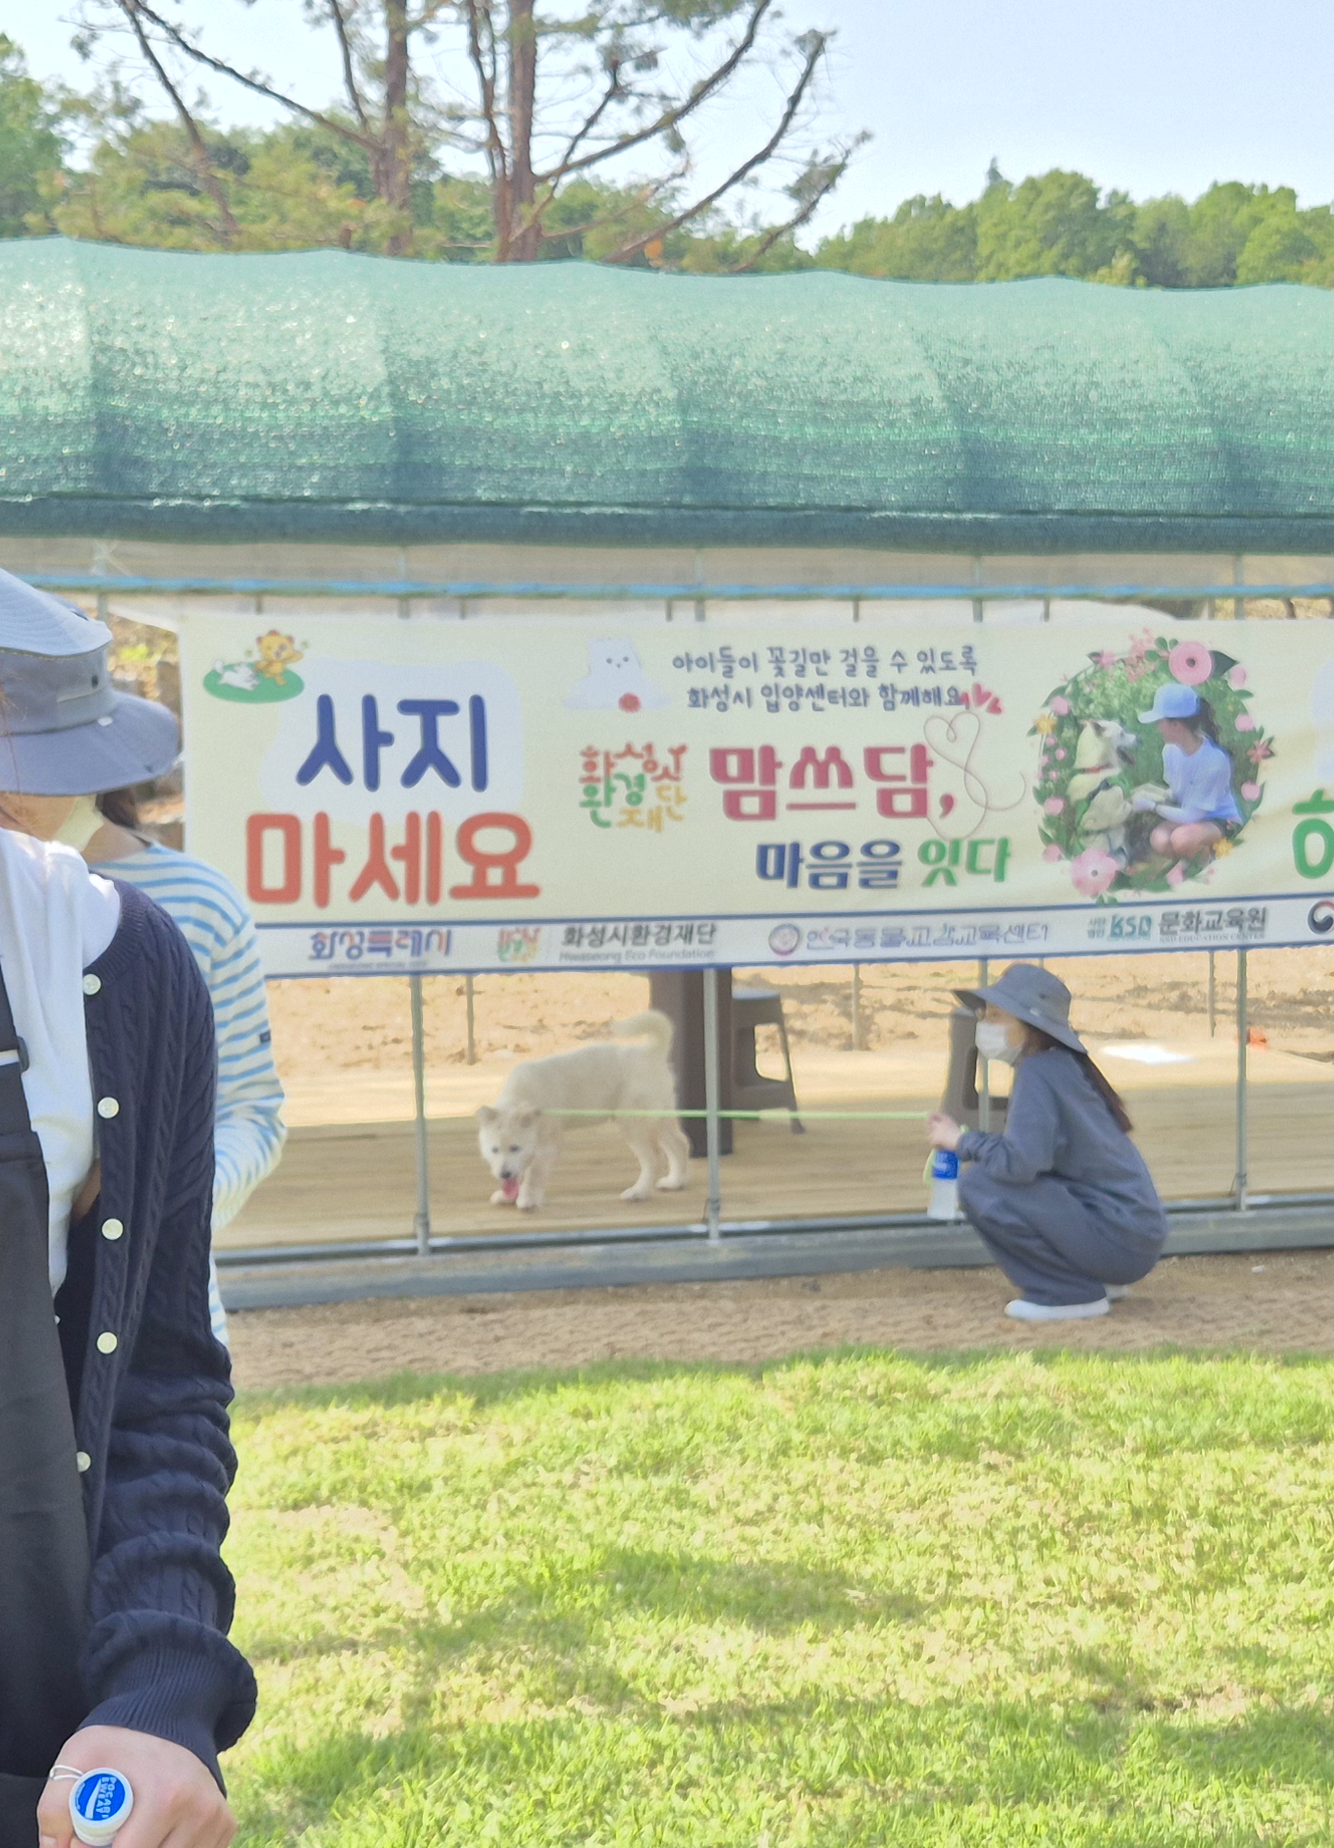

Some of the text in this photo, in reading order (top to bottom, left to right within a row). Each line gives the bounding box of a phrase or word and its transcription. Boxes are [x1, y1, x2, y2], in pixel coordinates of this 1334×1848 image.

[672, 645, 977, 678] 아이들이 꽃길만 걸을 수 있도록
[687, 682, 969, 713] 화성시 입양센터와 함께해요
[295, 693, 489, 792] 사지
[709, 742, 956, 821] 맘쓰담,
[246, 810, 541, 909] 마세요
[756, 836, 1012, 890] 마음을 잇다
[561, 922, 717, 949] 화성시환경재단
[1158, 905, 1267, 936] 문화교육원
[309, 928, 453, 960] 화성특례시
